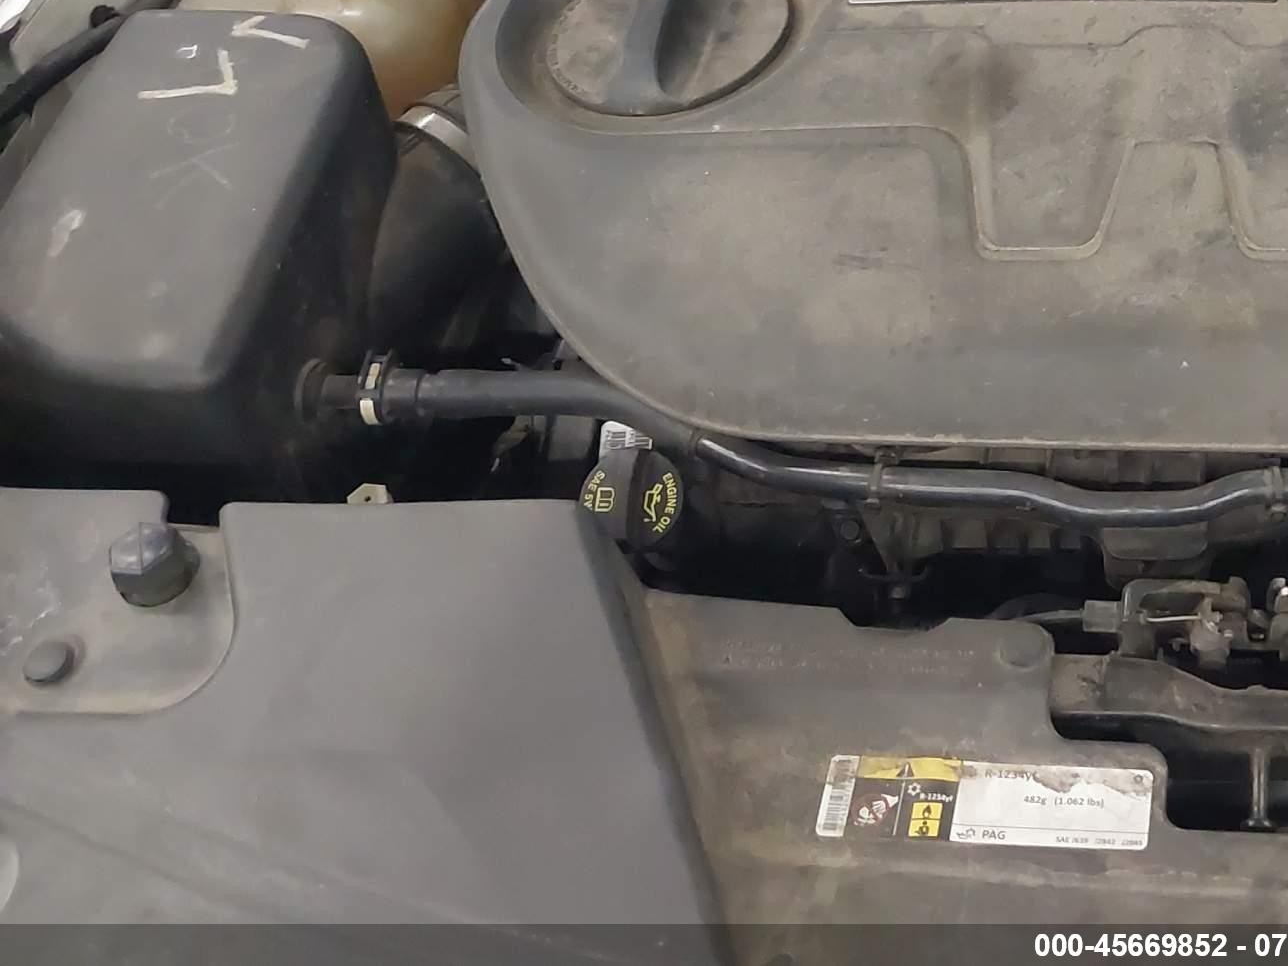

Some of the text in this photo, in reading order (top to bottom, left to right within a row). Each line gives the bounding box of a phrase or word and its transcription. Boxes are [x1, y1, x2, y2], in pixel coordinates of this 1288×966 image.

[587, 470, 606, 492] SAE
[652, 472, 678, 533] ENGINE OIL
[1023, 795, 1105, 809] 482g (1.062 lbs)
[981, 829, 1007, 840] PAG
